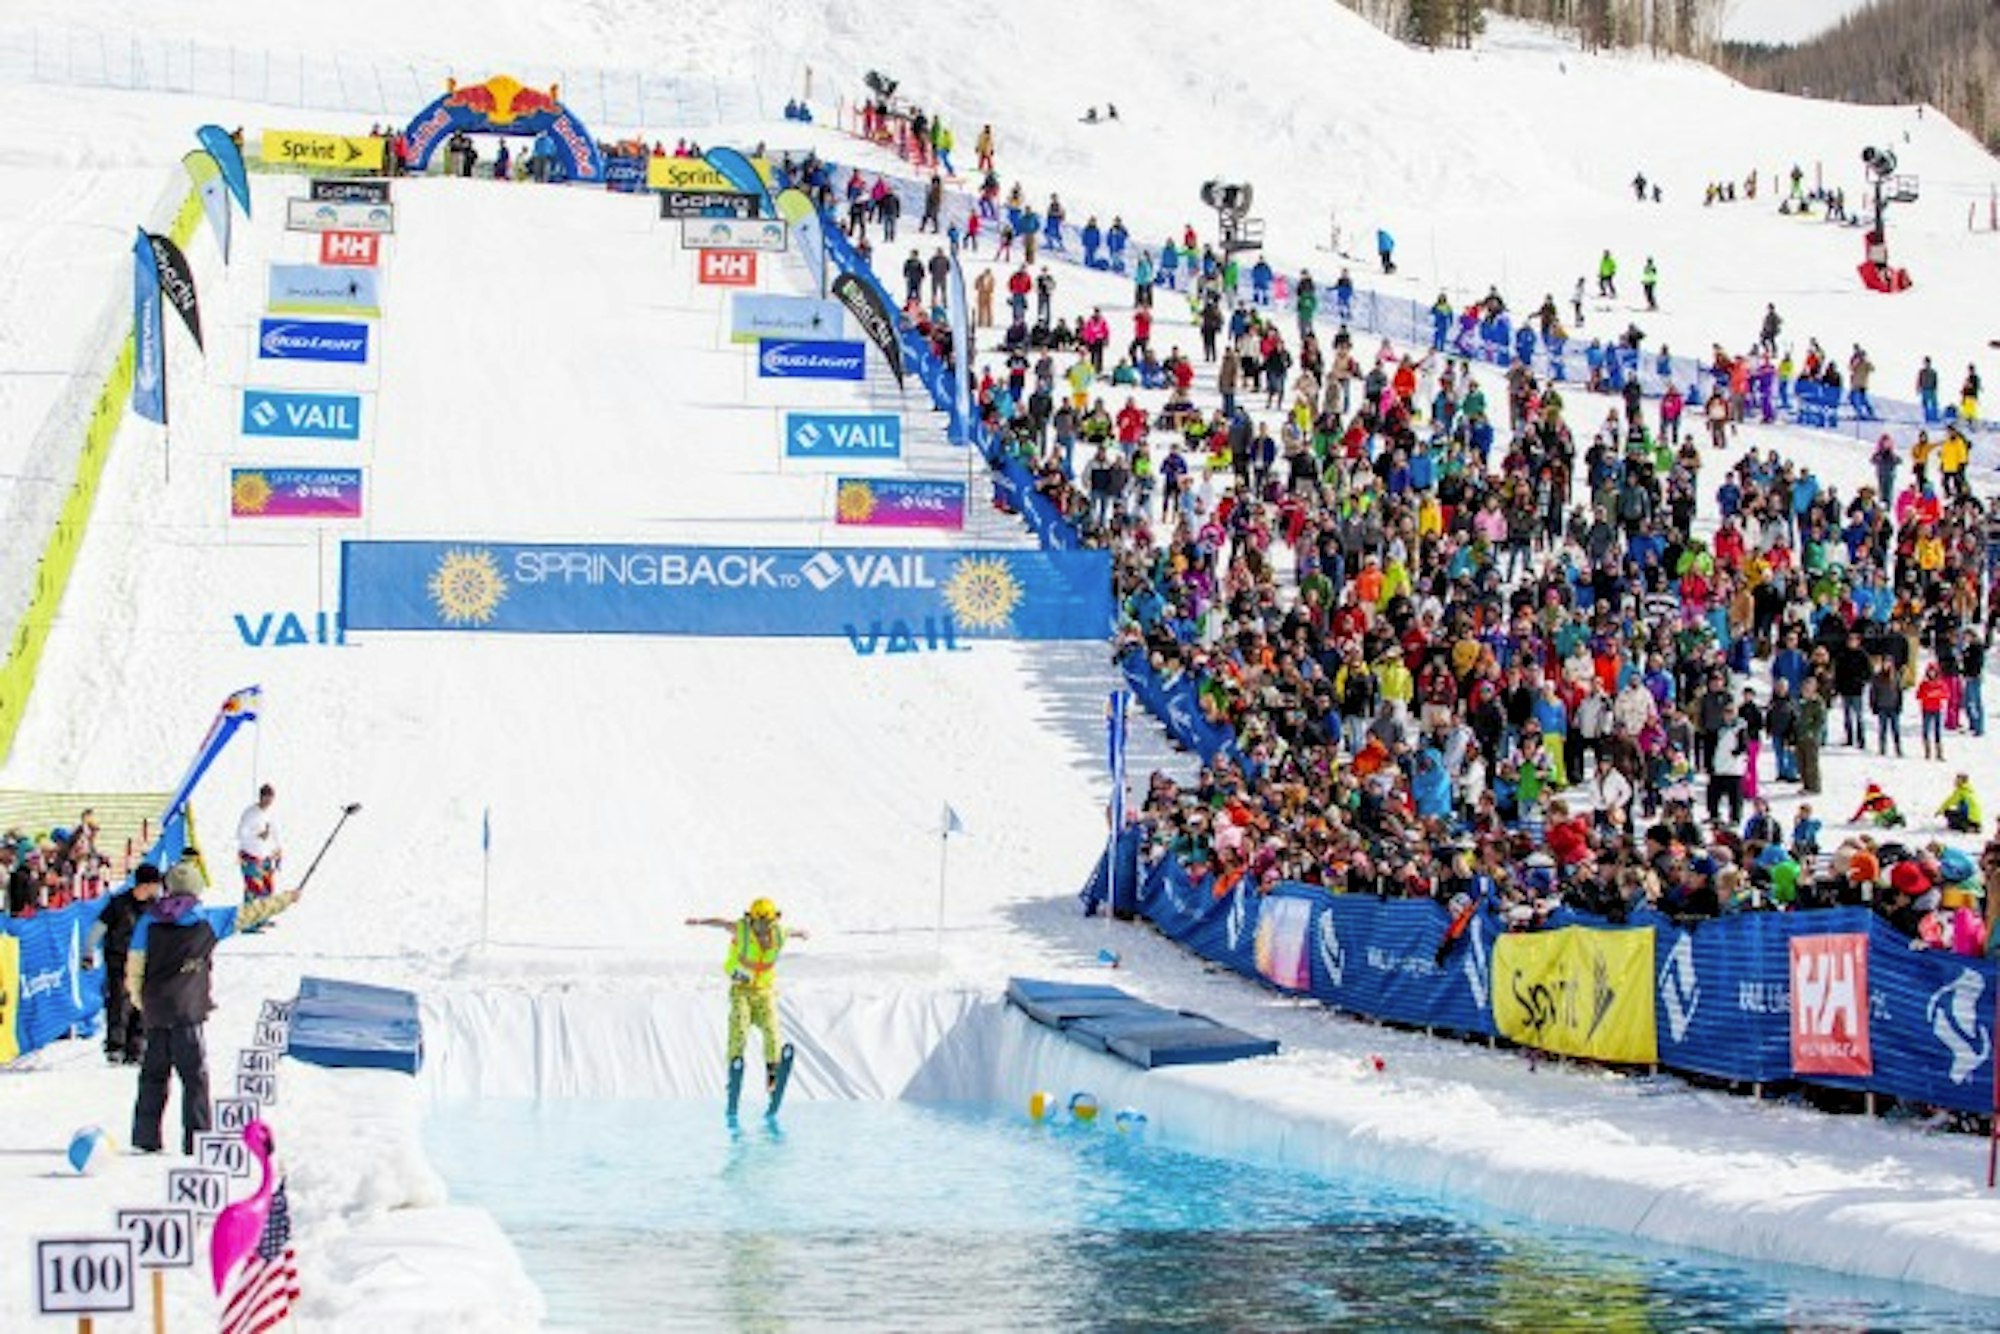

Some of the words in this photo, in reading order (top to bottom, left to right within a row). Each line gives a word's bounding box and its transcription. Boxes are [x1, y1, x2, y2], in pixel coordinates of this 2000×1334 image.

[282, 140, 335, 160] Sprint
[668, 164, 722, 187] Sprint
[670, 193, 749, 208] GoPro
[328, 234, 371, 258] HH
[705, 254, 749, 277] HH
[286, 402, 354, 430] VAIL
[827, 423, 895, 448] VAIL
[779, 573, 800, 588] TO
[845, 554, 935, 590] VAIL
[843, 614, 972, 657] VAIL
[1799, 952, 1858, 1038] HH
[243, 1053, 270, 1073] 40
[221, 1104, 254, 1129] 60
[206, 1143, 243, 1172] 70
[177, 1177, 221, 1210] 80
[128, 1218, 183, 1260] 90
[50, 1254, 123, 1295] 100
